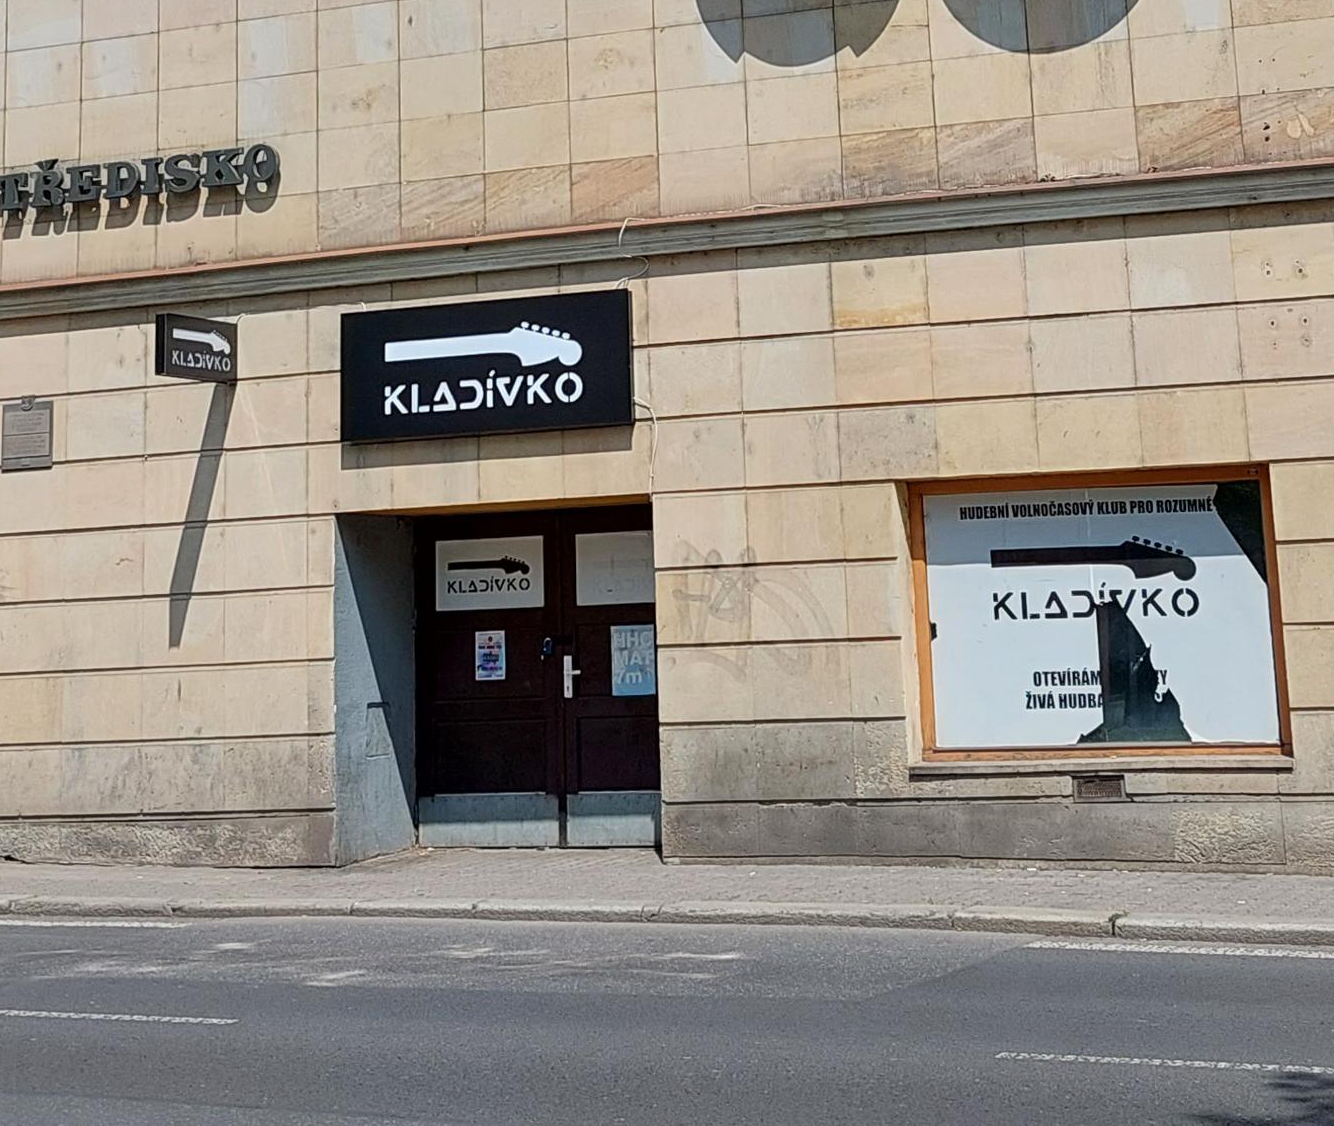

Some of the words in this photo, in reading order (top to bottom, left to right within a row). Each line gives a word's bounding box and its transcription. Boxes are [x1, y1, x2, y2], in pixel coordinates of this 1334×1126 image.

[171, 349, 231, 372] KLADÍVKO
[384, 369, 584, 416] KLADÍVKO
[959, 502, 1009, 521] HUDEBNÍ
[1011, 499, 1094, 518] VOLNOČASOVÝ
[1097, 500, 1127, 515] KLUB
[1129, 500, 1154, 514] PRO
[1156, 495, 1213, 513] ROZUMNÉ
[447, 575, 531, 594] KLADÍVKO
[1025, 690, 1055, 710] ŽIVÁ
